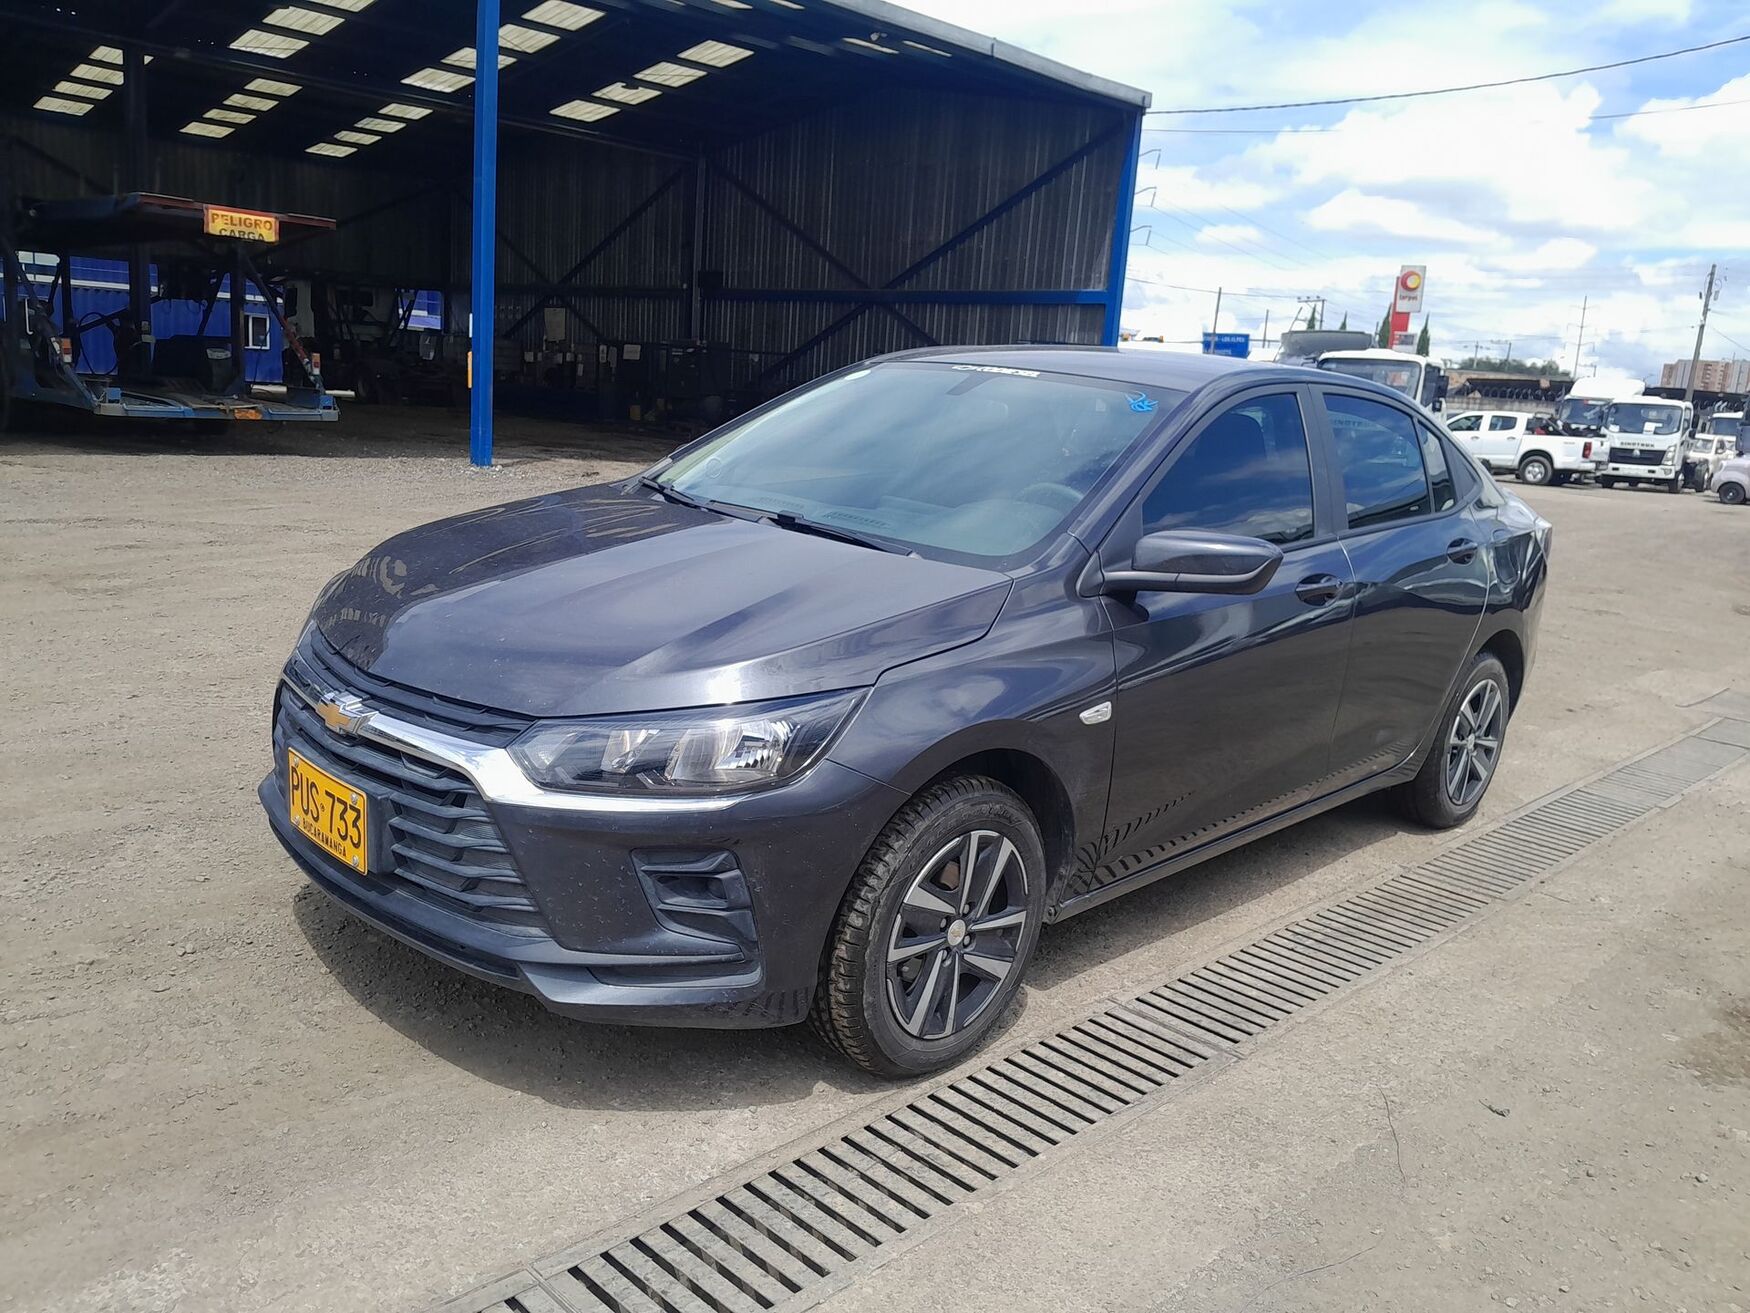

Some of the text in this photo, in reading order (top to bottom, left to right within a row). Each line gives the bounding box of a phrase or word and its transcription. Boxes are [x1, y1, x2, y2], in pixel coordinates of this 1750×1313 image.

[211, 212, 273, 231] PELIGRO
[291, 765, 361, 849] PUS 733
[302, 817, 347, 857] BUCARAMANGA
